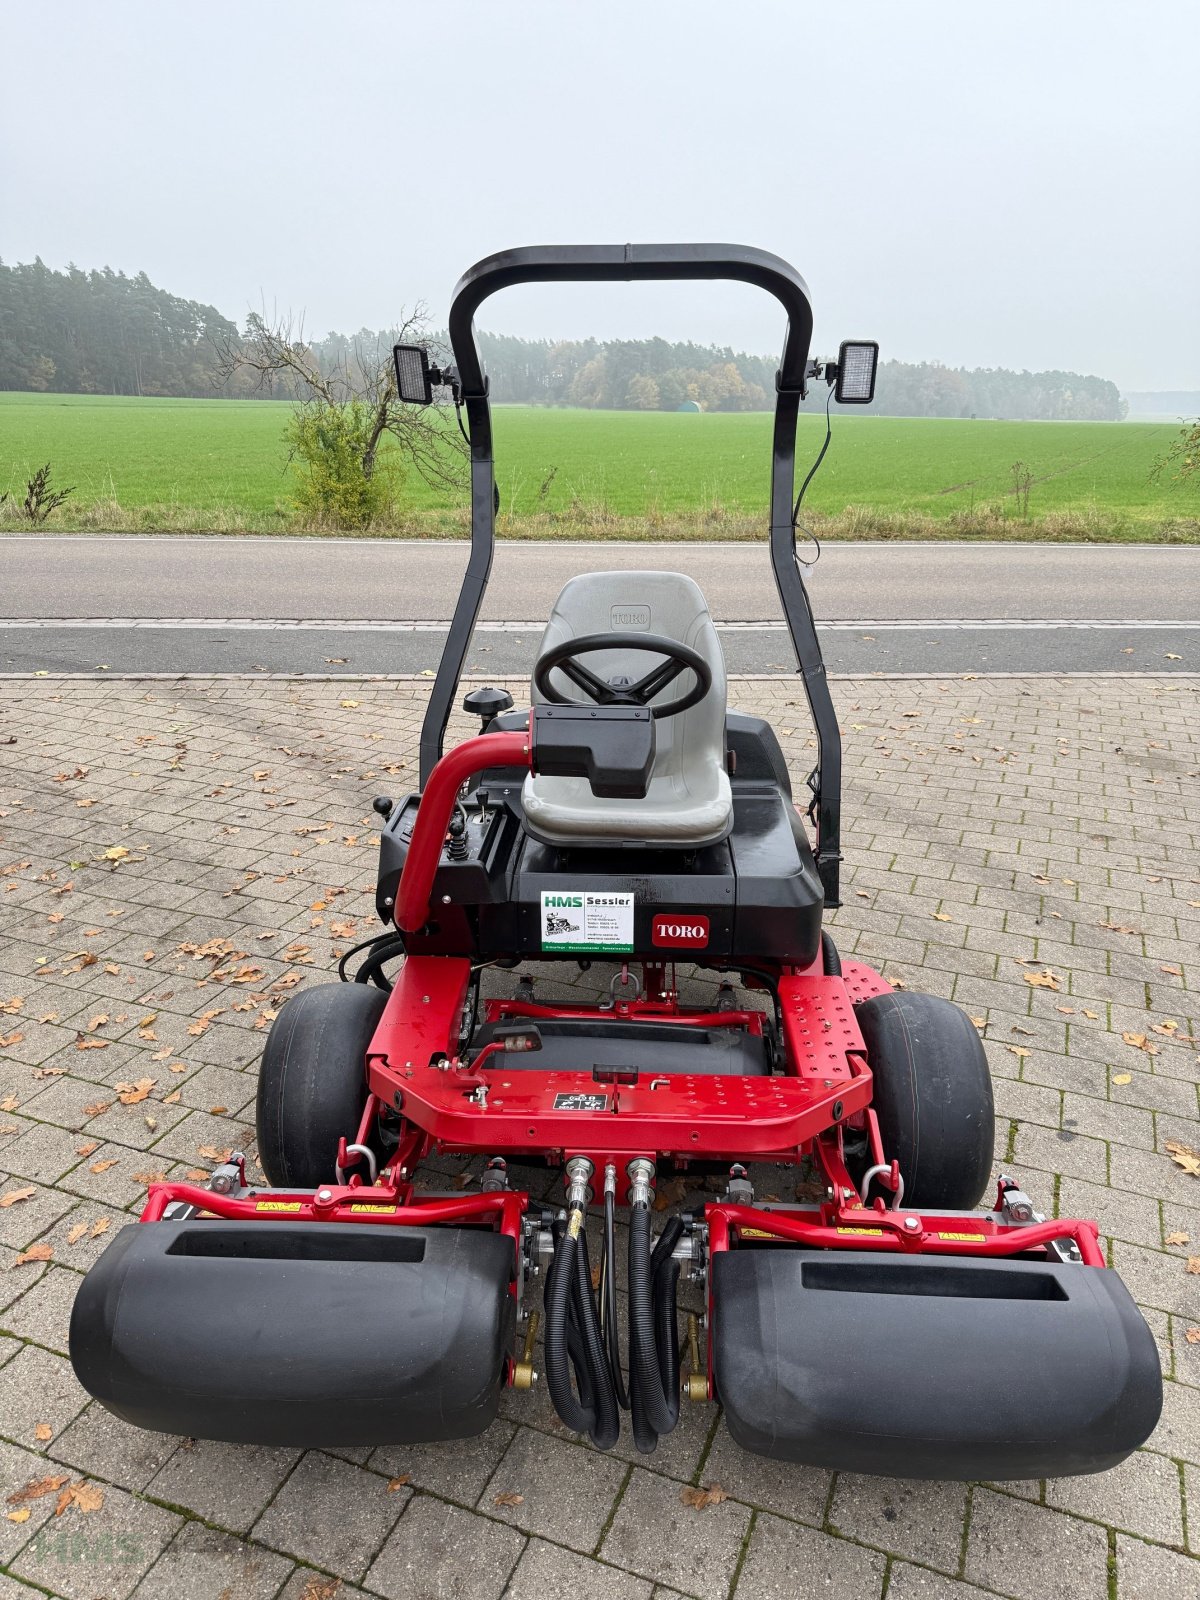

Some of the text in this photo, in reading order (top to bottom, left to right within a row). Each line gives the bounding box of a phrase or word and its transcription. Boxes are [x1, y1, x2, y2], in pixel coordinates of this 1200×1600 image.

[613, 612, 648, 625] TORO
[545, 896, 631, 908] HMS Sessler
[656, 924, 706, 939] TORO
